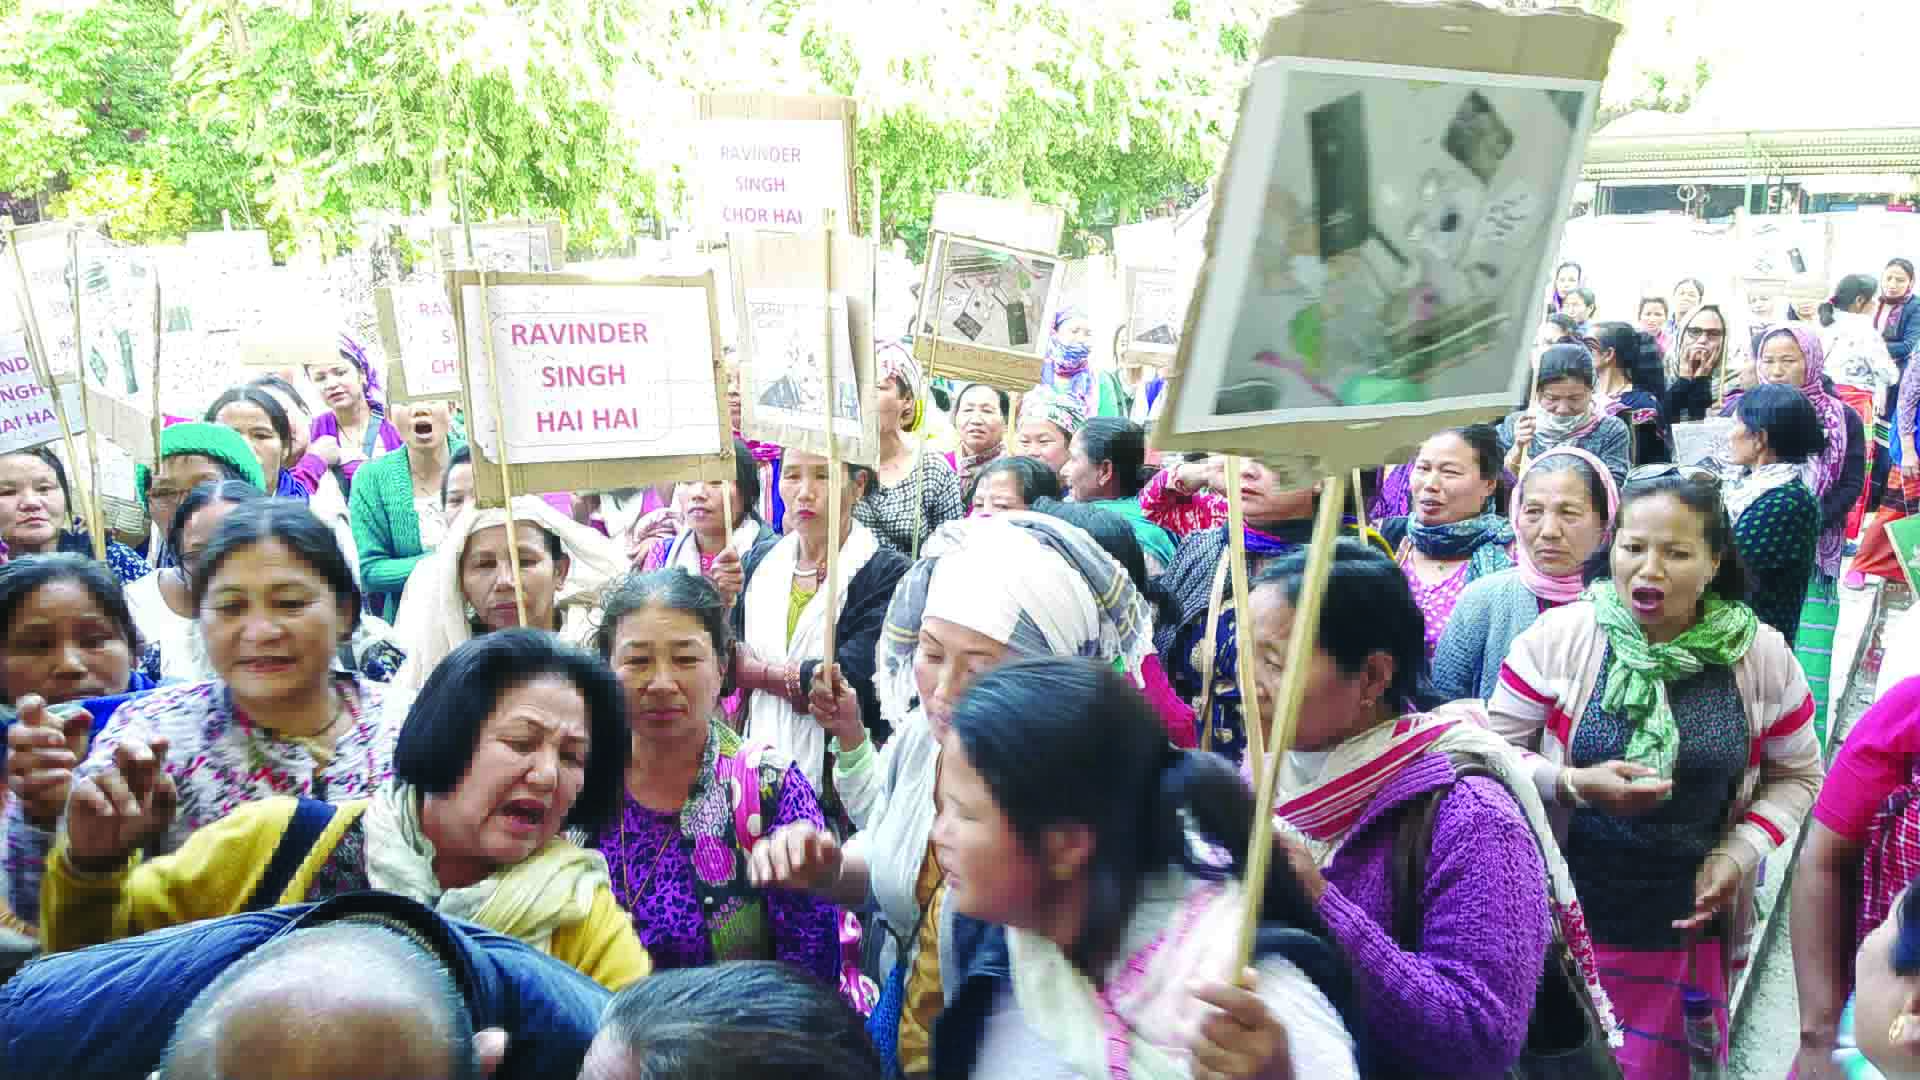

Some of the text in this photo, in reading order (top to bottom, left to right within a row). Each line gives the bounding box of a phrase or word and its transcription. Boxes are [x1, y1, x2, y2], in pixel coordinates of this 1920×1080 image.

[720, 144, 801, 163] RAVINDER
[735, 176, 785, 193] SINGH
[722, 207, 803, 225] CHOR HAI
[511, 322, 649, 346] RAVINDER
[541, 363, 626, 388] SINGH
[0, 415, 22, 434] AI
[536, 407, 639, 433] HAI HAI
